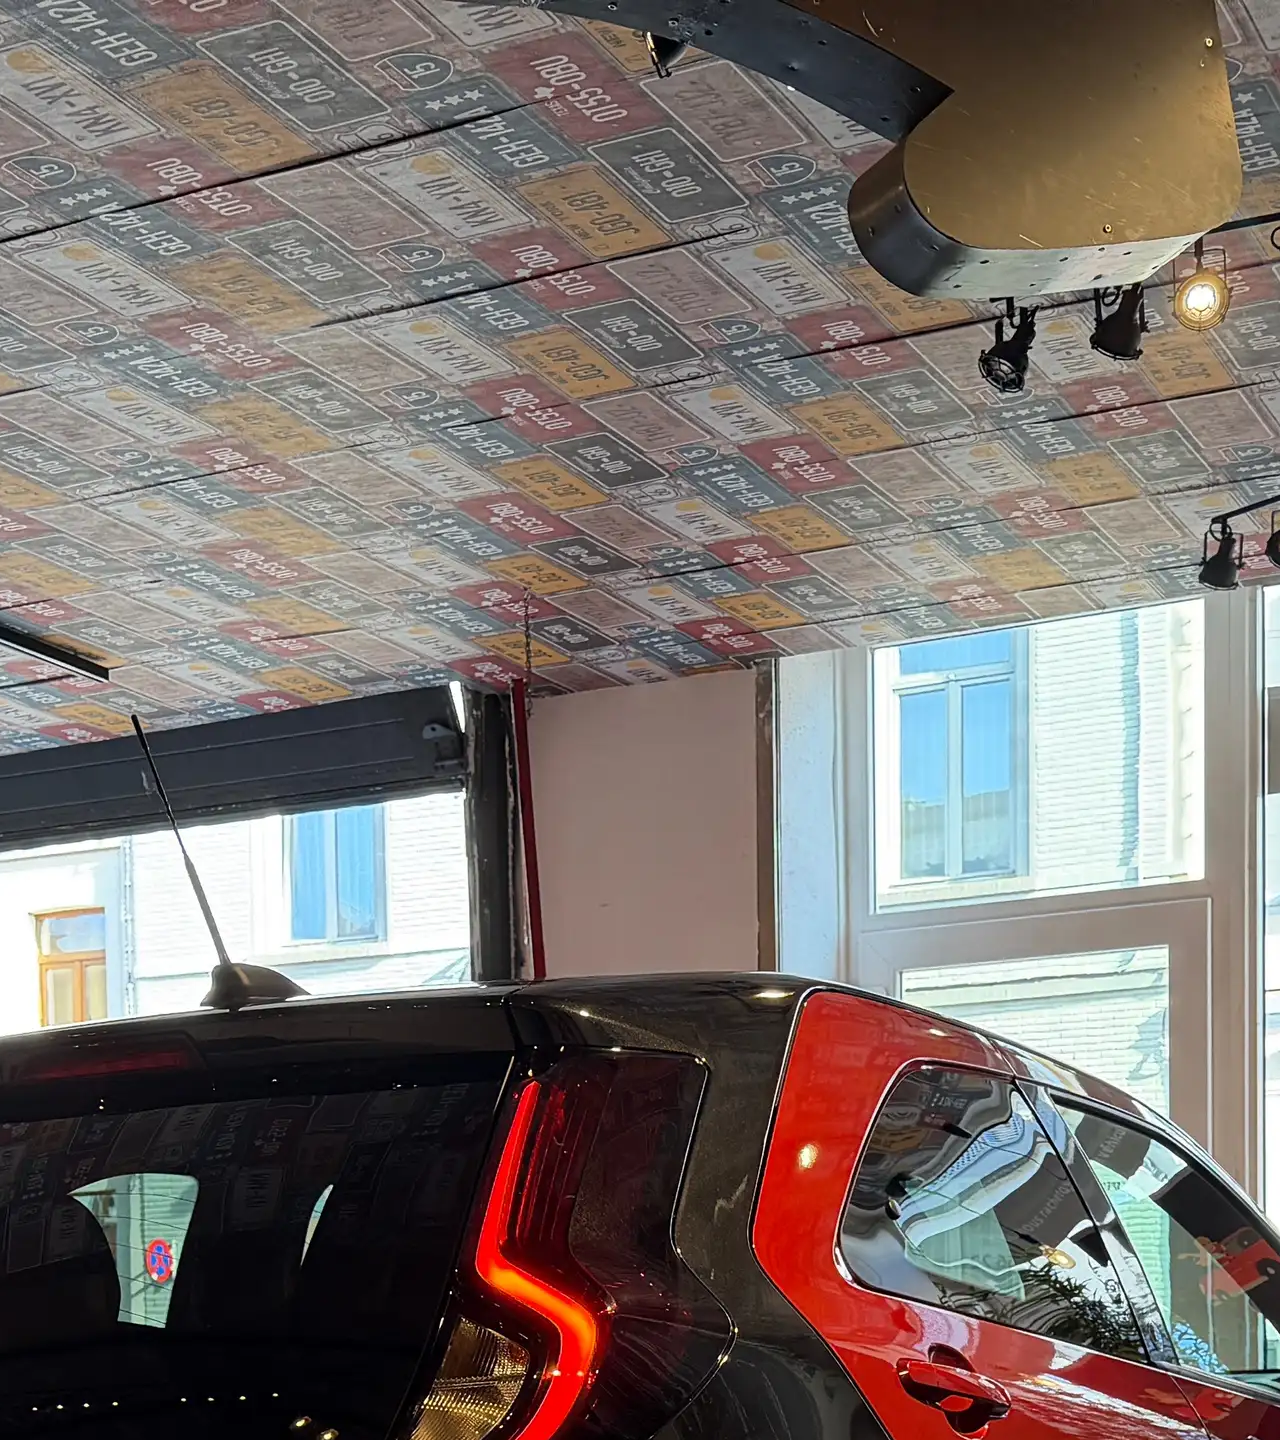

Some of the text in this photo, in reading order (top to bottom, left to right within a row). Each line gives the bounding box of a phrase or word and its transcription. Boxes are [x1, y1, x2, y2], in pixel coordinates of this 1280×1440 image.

[402, 61, 440, 79] 15
[28, 163, 64, 178] 15
[769, 161, 804, 177] 15
[401, 249, 434, 263] 15
